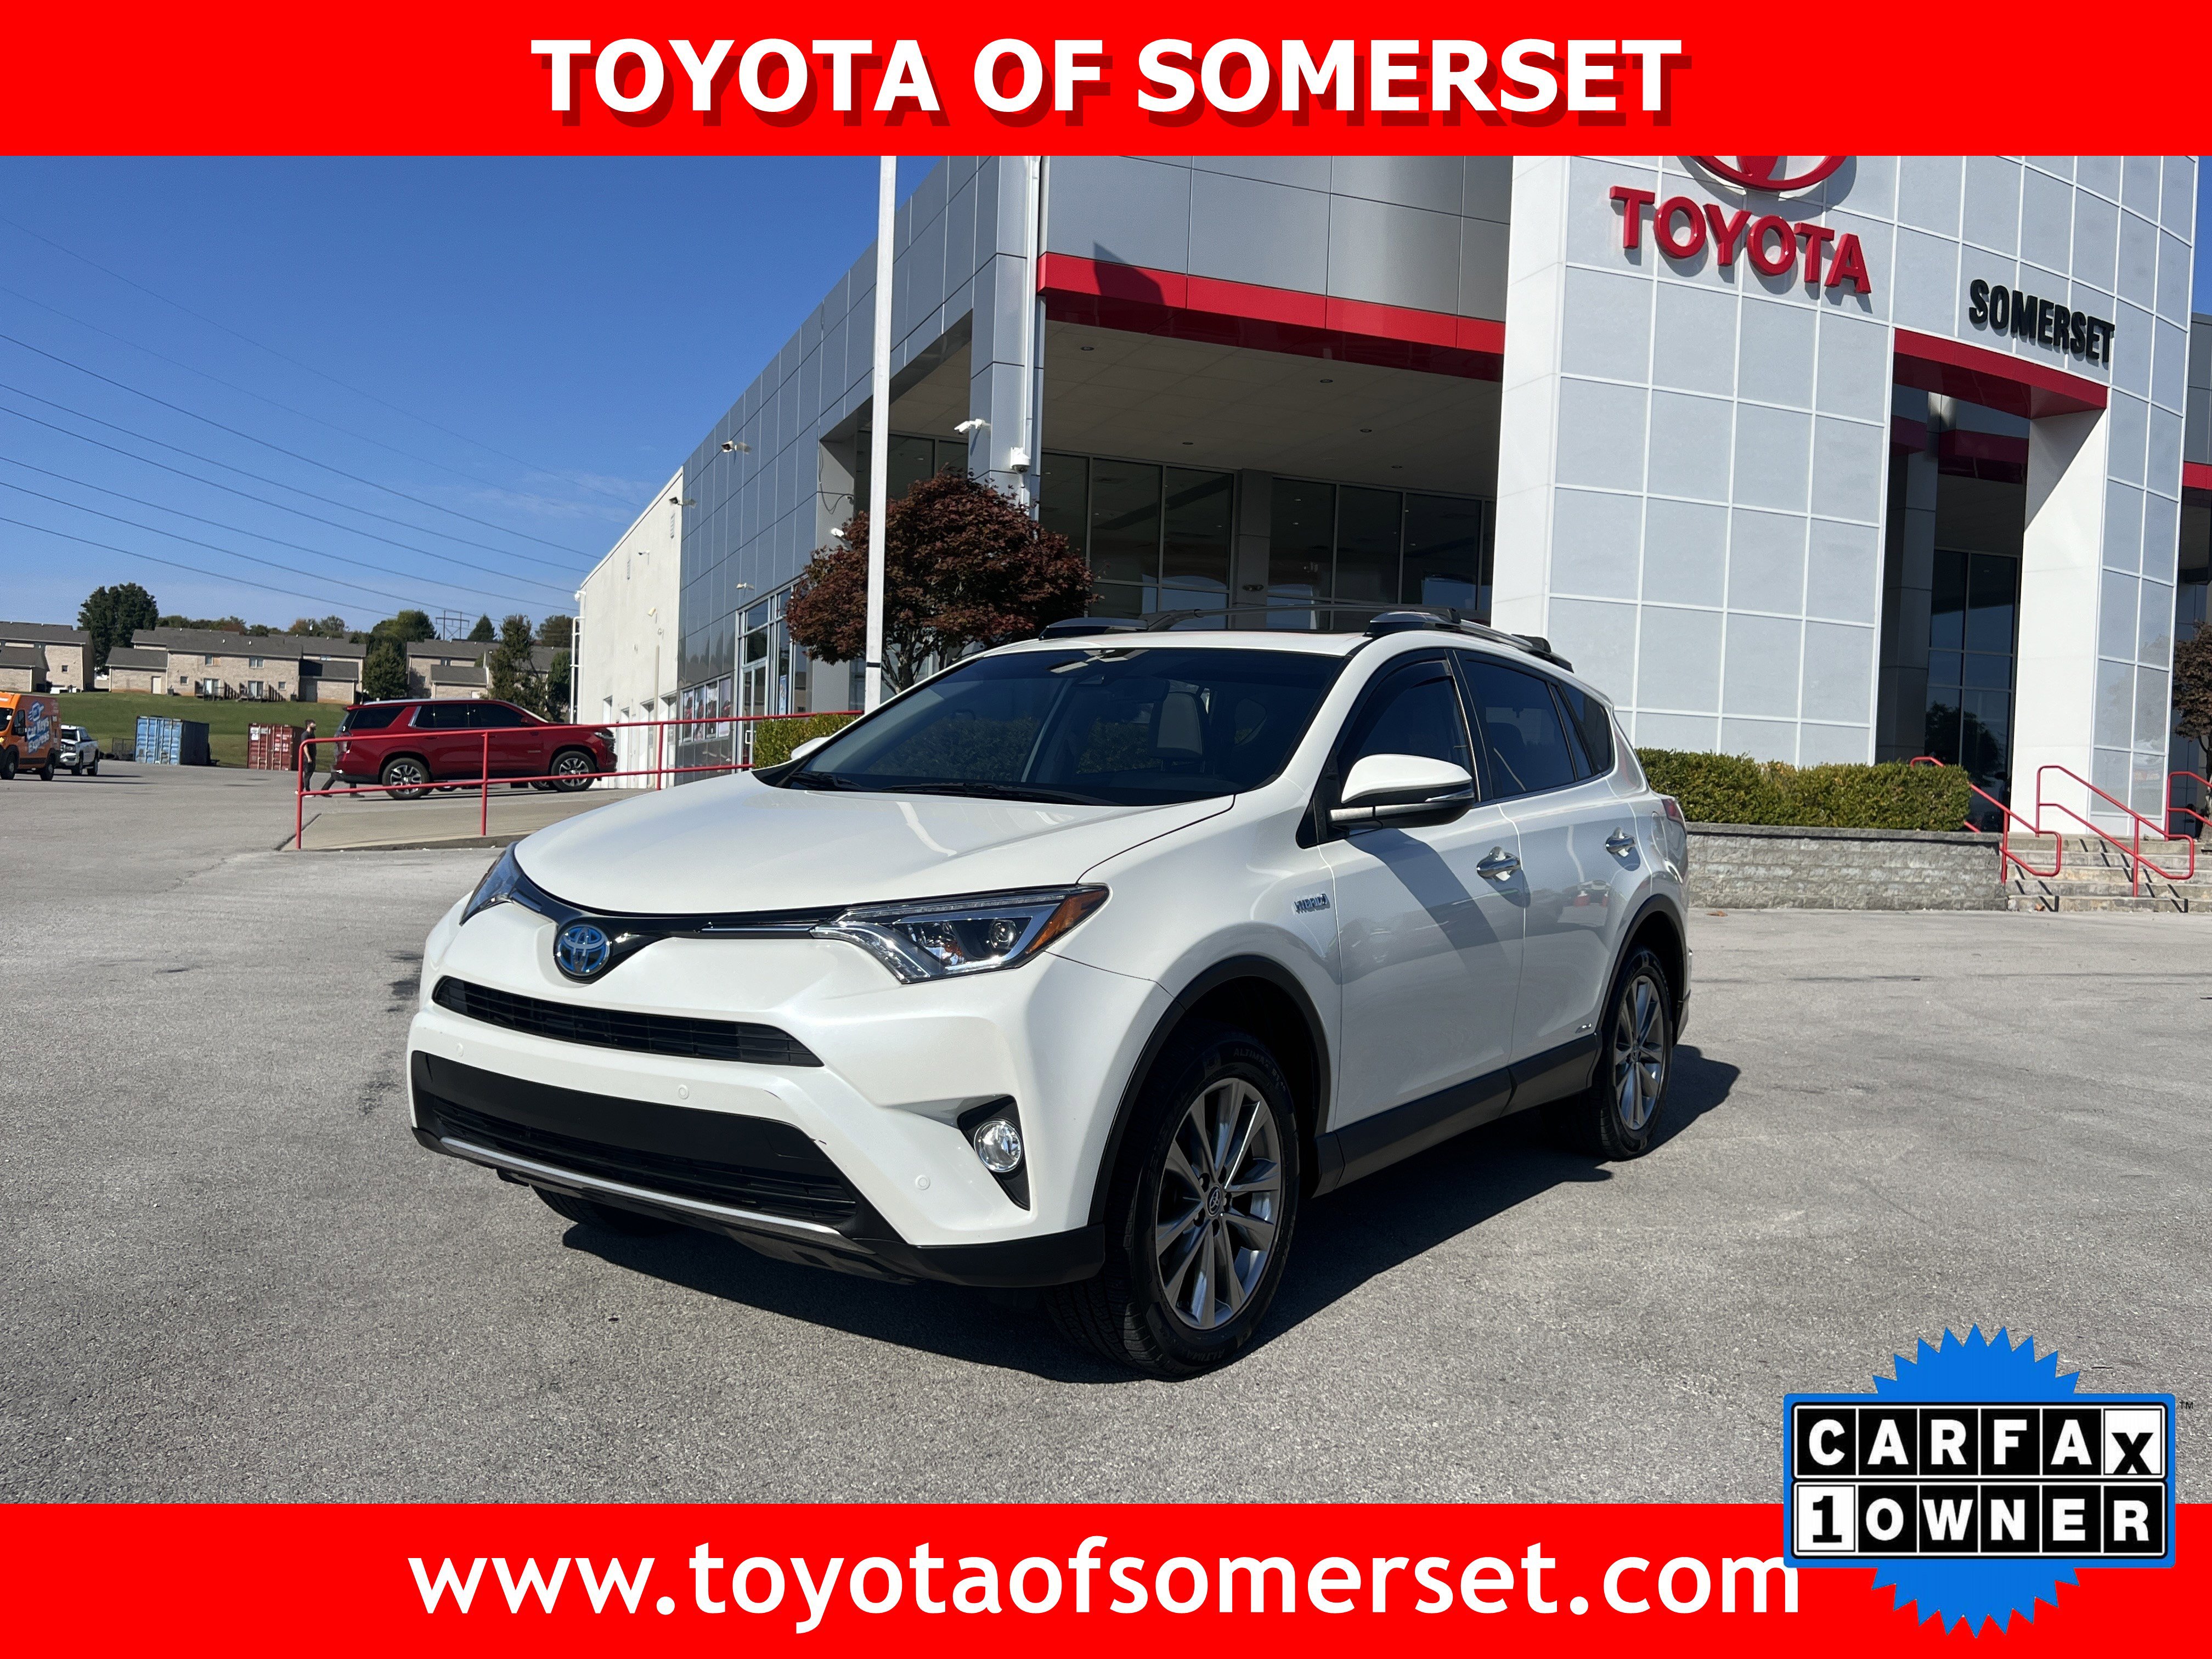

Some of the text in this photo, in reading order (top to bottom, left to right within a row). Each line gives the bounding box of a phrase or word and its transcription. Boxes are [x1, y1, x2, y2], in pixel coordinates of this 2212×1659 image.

[1610, 185, 1871, 294] TOYOTA
[1970, 279, 2115, 364] SOMERSET
[1294, 894, 1330, 911] HYBRID
